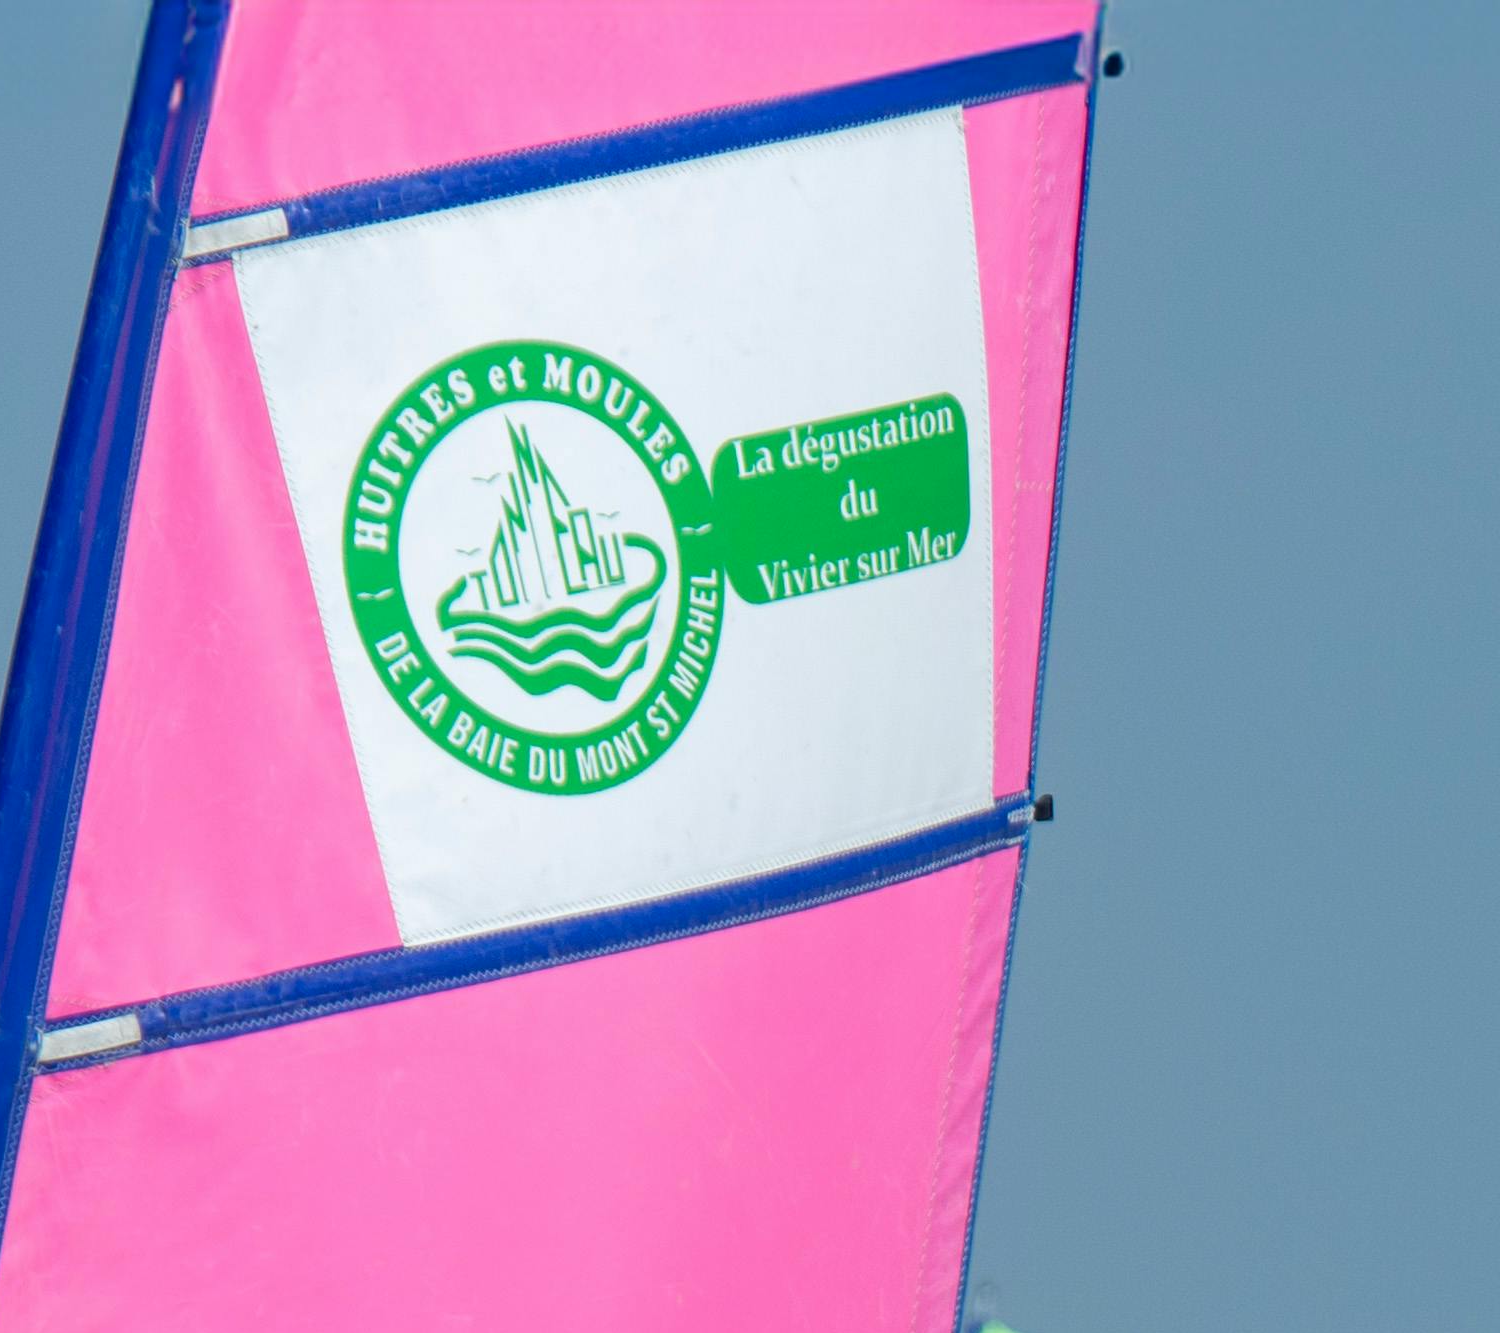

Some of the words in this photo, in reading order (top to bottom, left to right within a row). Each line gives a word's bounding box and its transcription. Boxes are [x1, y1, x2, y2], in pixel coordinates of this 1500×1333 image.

[354, 368, 474, 552] HUITRES
[487, 355, 528, 392] et
[542, 353, 691, 483] MOULES
[733, 440, 775, 478] La
[782, 402, 955, 473] dégustation
[840, 479, 879, 521] du
[757, 554, 850, 600] Vivier
[857, 545, 900, 580] sur
[906, 527, 956, 568] Mer
[375, 631, 422, 682] DE
[408, 678, 449, 728] LA
[447, 711, 519, 775] BAIE
[528, 745, 565, 785] DU
[575, 721, 650, 783] MONT
[646, 691, 681, 738] ST
[668, 569, 719, 700] MICHEL
